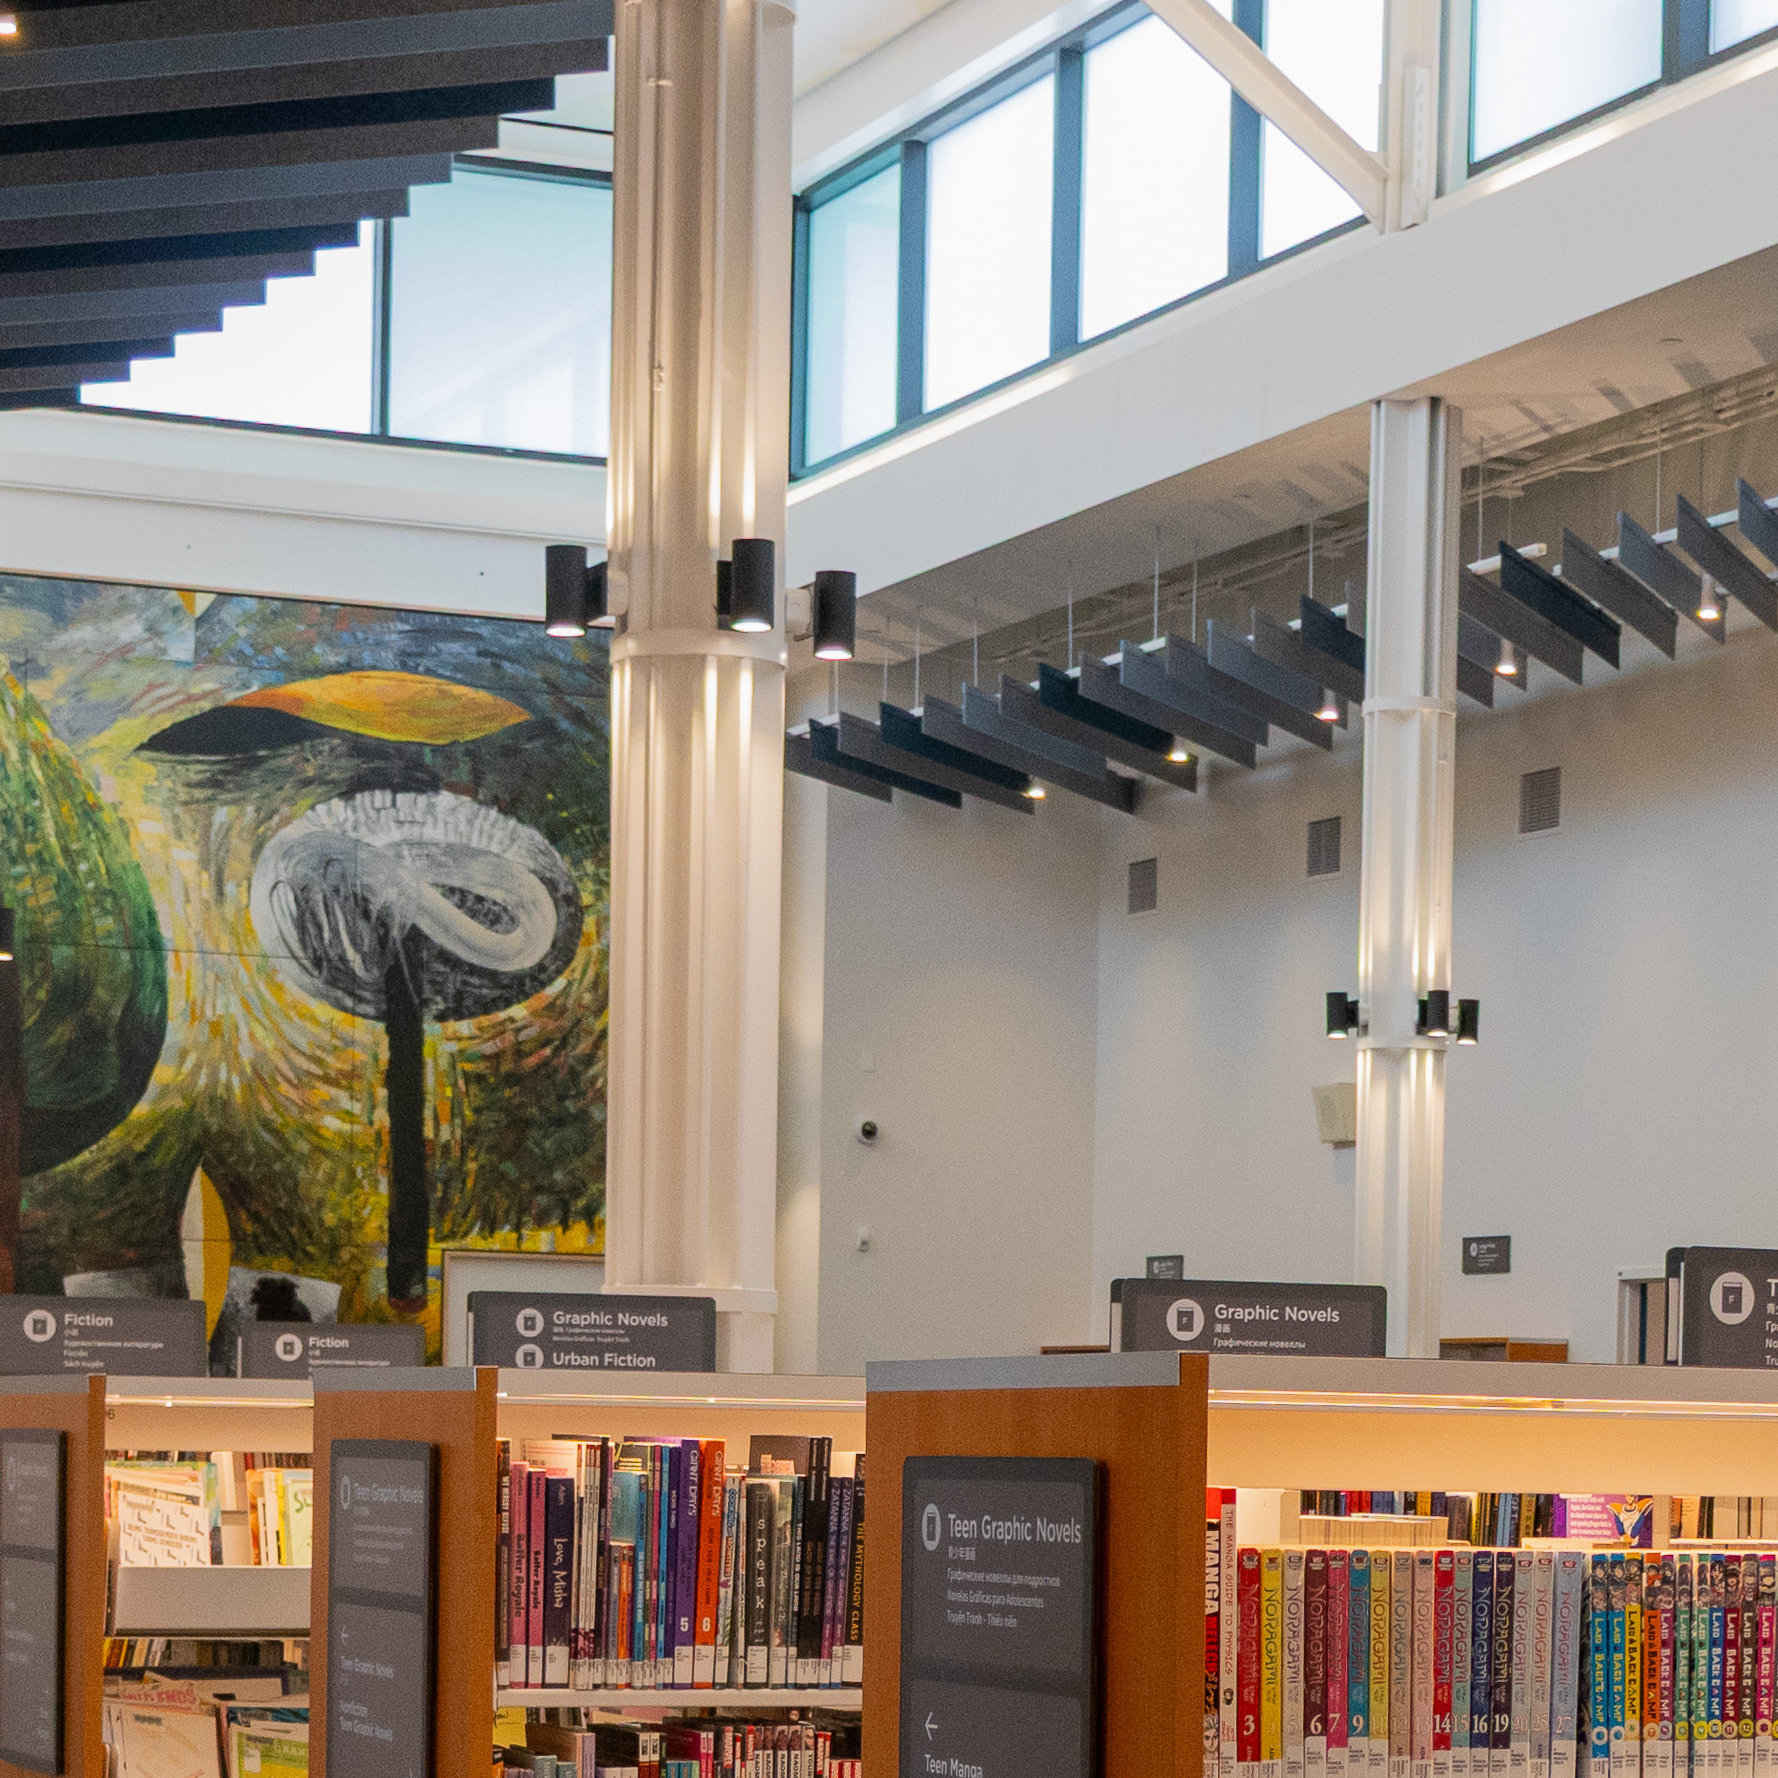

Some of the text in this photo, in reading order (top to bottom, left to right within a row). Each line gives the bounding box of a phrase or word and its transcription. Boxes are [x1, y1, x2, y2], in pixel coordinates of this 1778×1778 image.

[64, 1313, 114, 1327] Fiction
[553, 1311, 669, 1328] Graphic Novels
[1215, 1304, 1340, 1326] Graphic Novels
[309, 1336, 349, 1348] Fiction
[553, 1352, 656, 1368] Urban Fiction
[830, 1488, 839, 1533] ZATANNA
[948, 1513, 1081, 1544] Teen Graphic Novels
[553, 1537, 569, 1609] Love, Misha
[755, 1518, 766, 1609] speak
[1205, 1530, 1220, 1615] MANGA
[853, 1543, 865, 1609] MYTHOLOGY
[511, 1574, 523, 1618] Royale
[1224, 1510, 1233, 1676] THE MANGA GUIDE TO PHYSICS
[680, 1618, 689, 1632] 5
[702, 1618, 711, 1632] 6
[850, 1610, 860, 1641] CLASS
[1243, 1715, 1255, 1735] 3
[1309, 1715, 1322, 1734] 6
[1352, 1715, 1364, 1734] 9
[1434, 1715, 1452, 1734] 14
[1472, 1715, 1488, 1734] 16
[1494, 1715, 1509, 1733] 19
[924, 1754, 948, 1775] Teen
